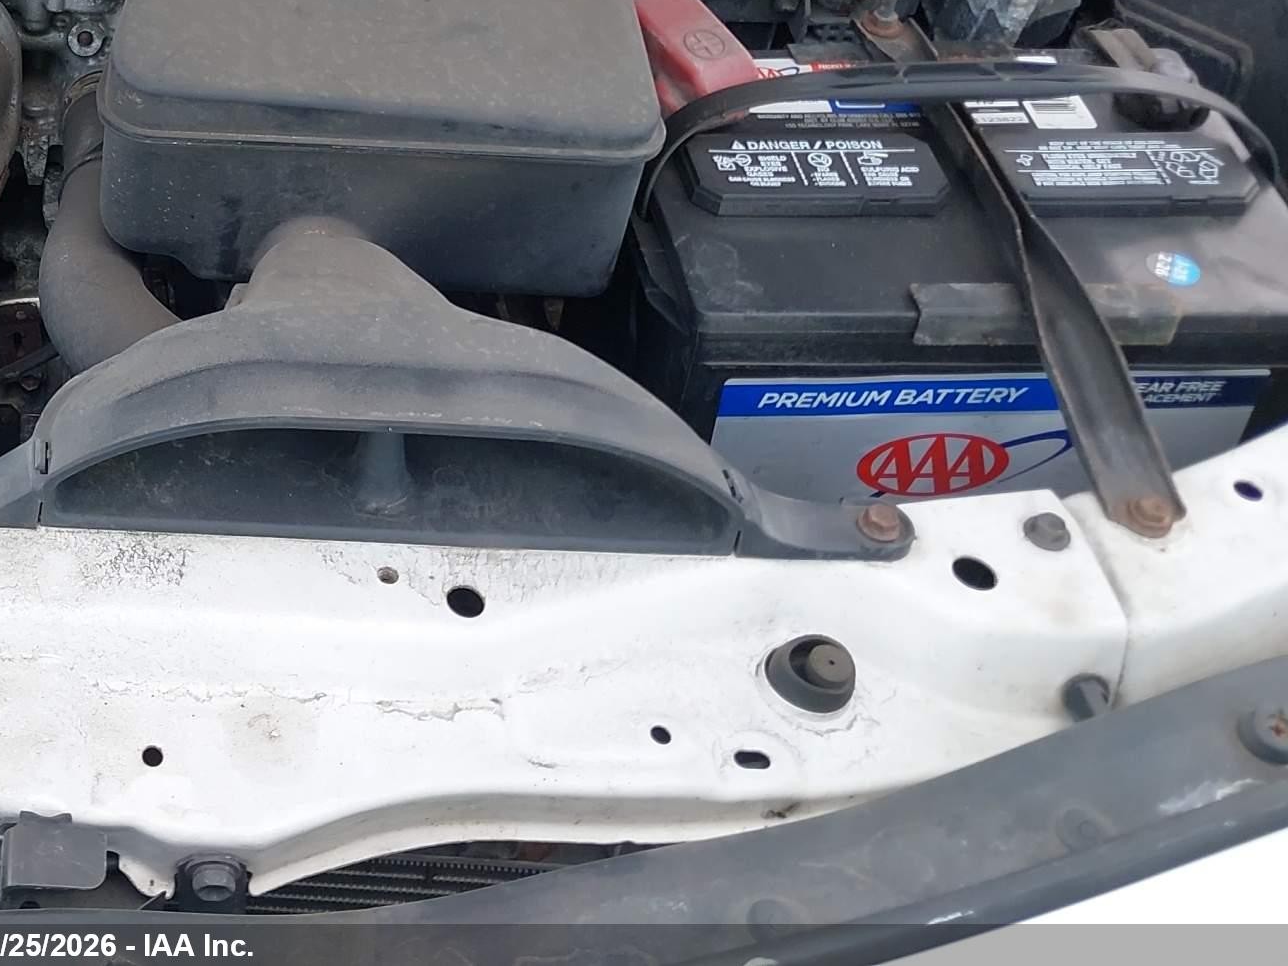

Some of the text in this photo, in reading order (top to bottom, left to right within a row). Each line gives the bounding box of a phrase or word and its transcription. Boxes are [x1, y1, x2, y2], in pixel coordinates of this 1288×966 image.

[746, 140, 810, 150] DANGER
[825, 140, 883, 150] POISON
[1135, 381, 1227, 393] EAR FREE
[758, 387, 1029, 409] PREMIUM BATTERY
[1143, 392, 1218, 403] ACEMENT
[862, 433, 1001, 496] AAA
